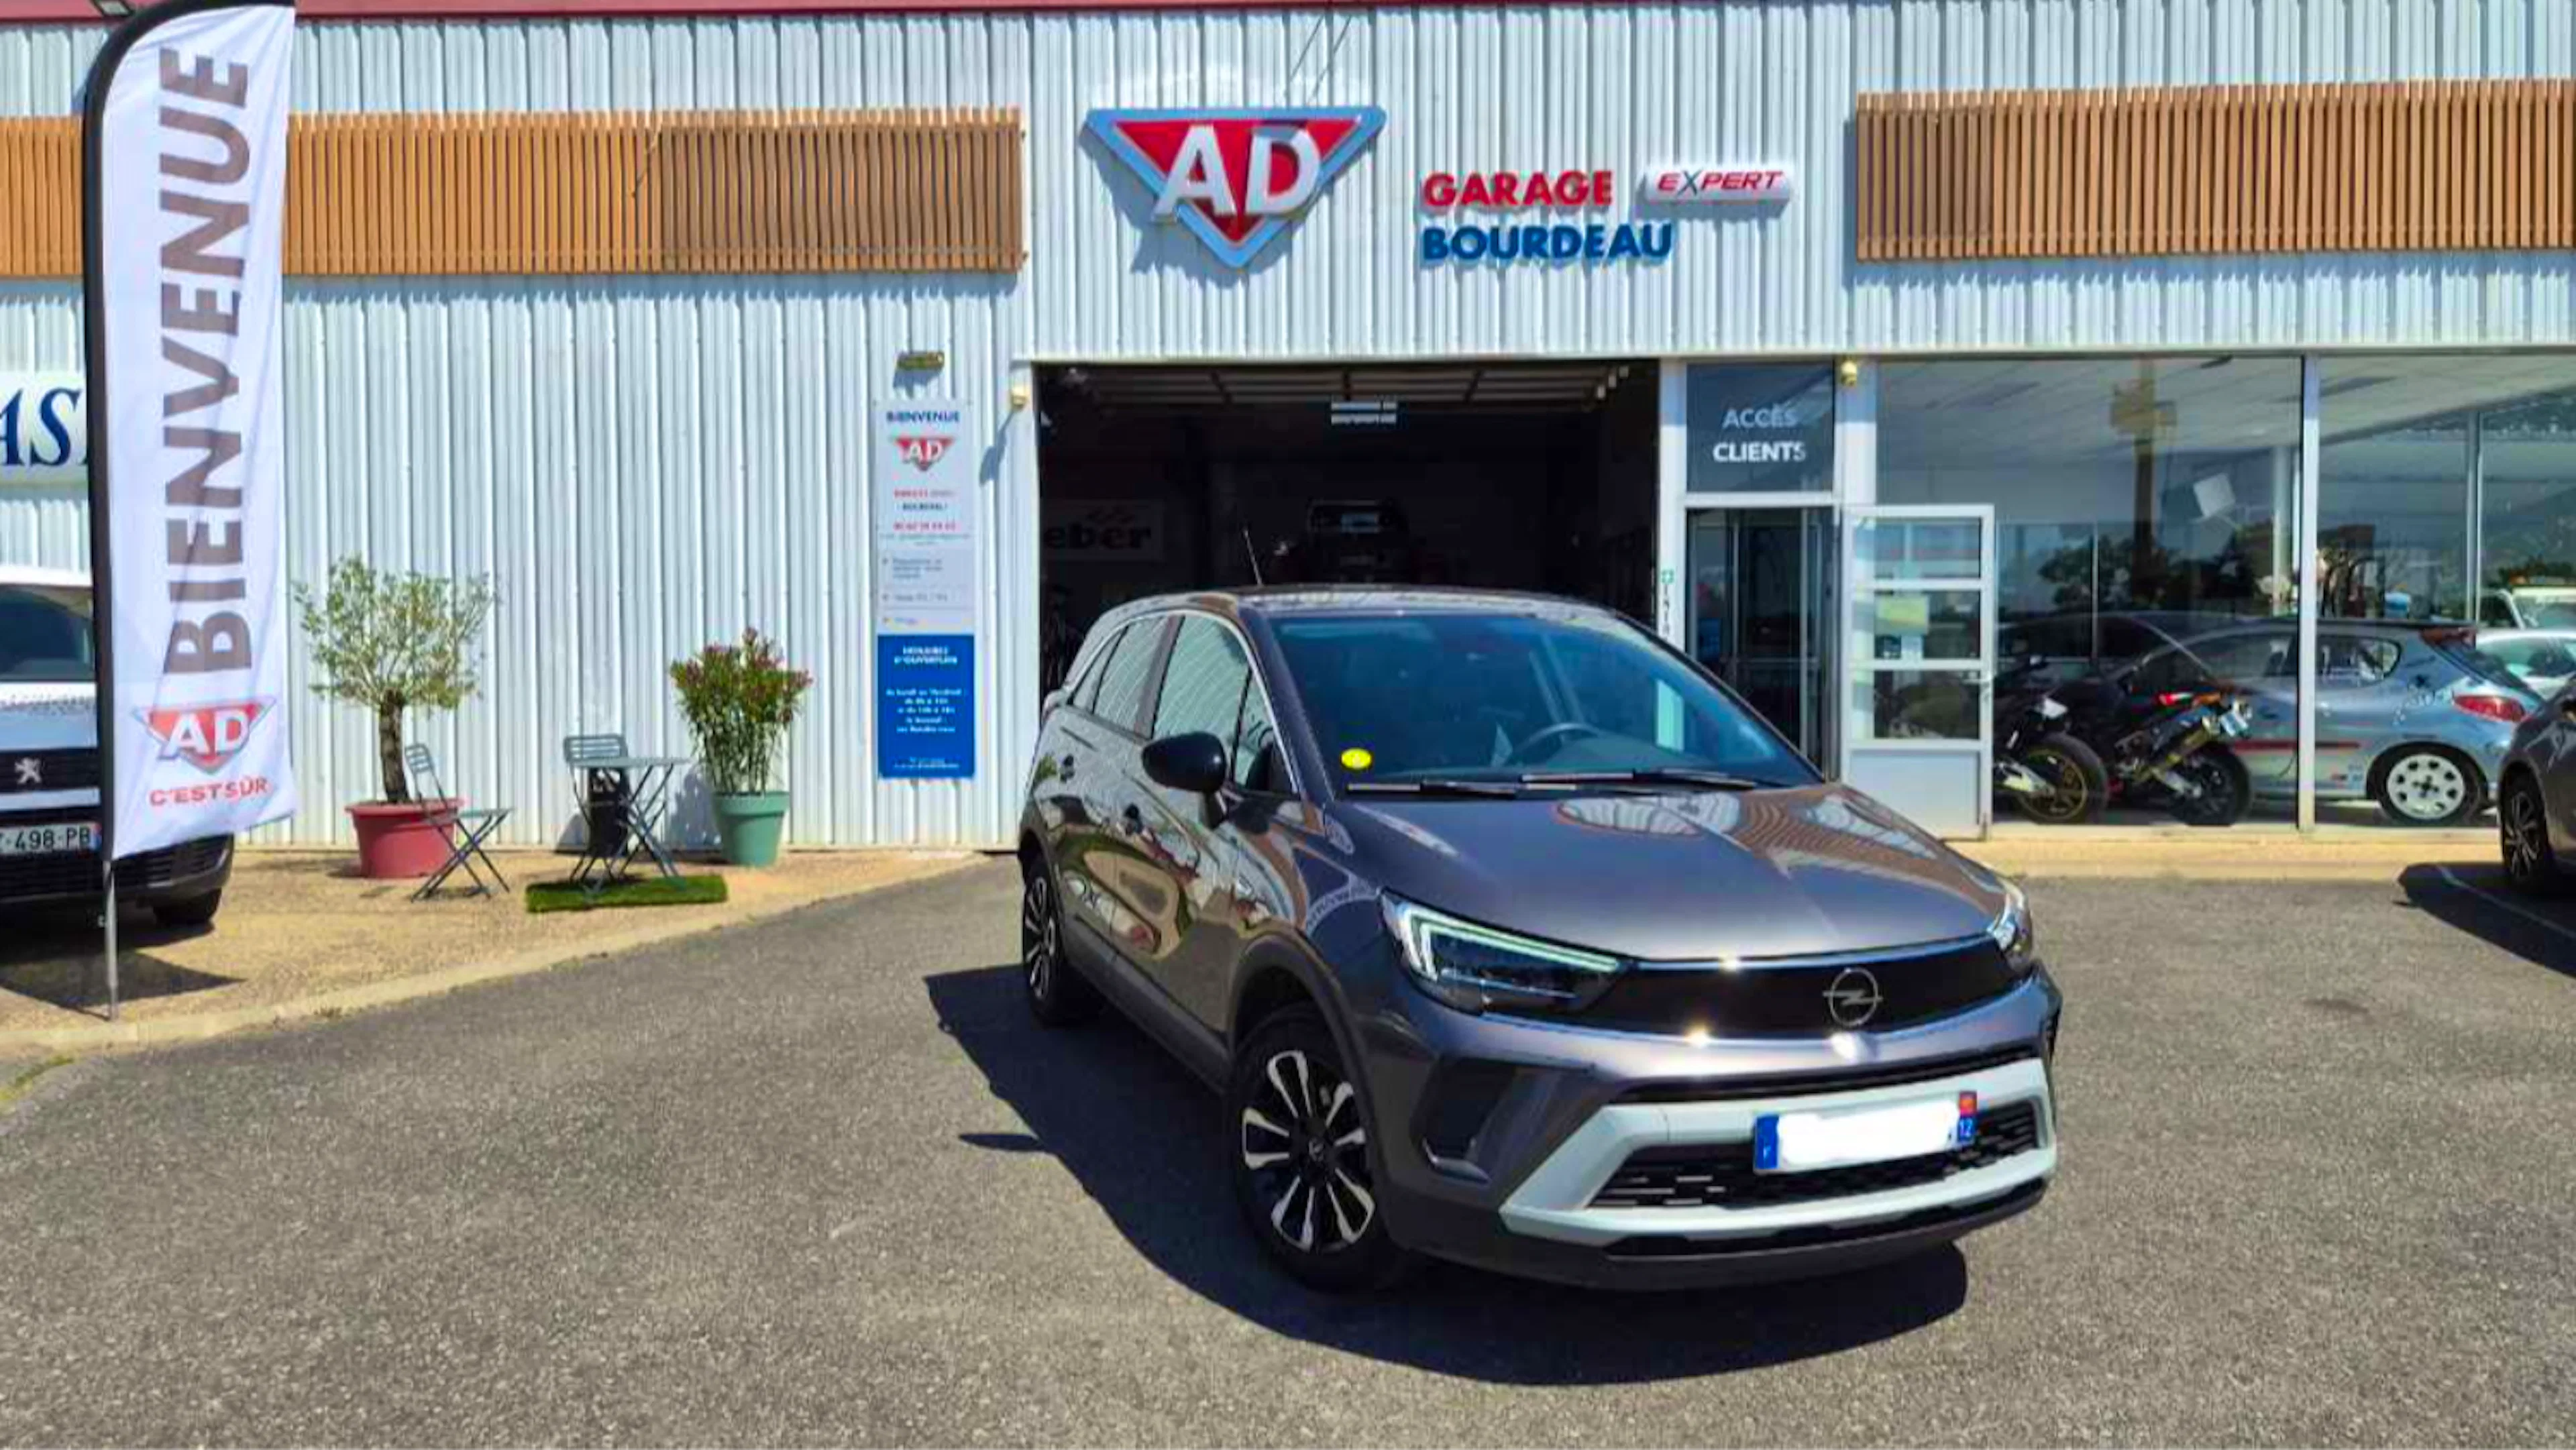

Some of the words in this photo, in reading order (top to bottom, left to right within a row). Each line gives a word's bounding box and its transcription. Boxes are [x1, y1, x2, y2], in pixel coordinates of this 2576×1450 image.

[1150, 123, 1323, 223] AD
[1421, 170, 1613, 208] GARAGE
[1657, 168, 1784, 195] EXPERT
[1421, 223, 1672, 263] BOURDEAU
[158, 47, 252, 674] BIENVENUE
[886, 410, 960, 423] BIENVENUE
[901, 439, 943, 463] AD
[1713, 441, 1807, 463] CLIENTS
[158, 706, 251, 760] AD
[149, 785, 223, 806] C'EST
